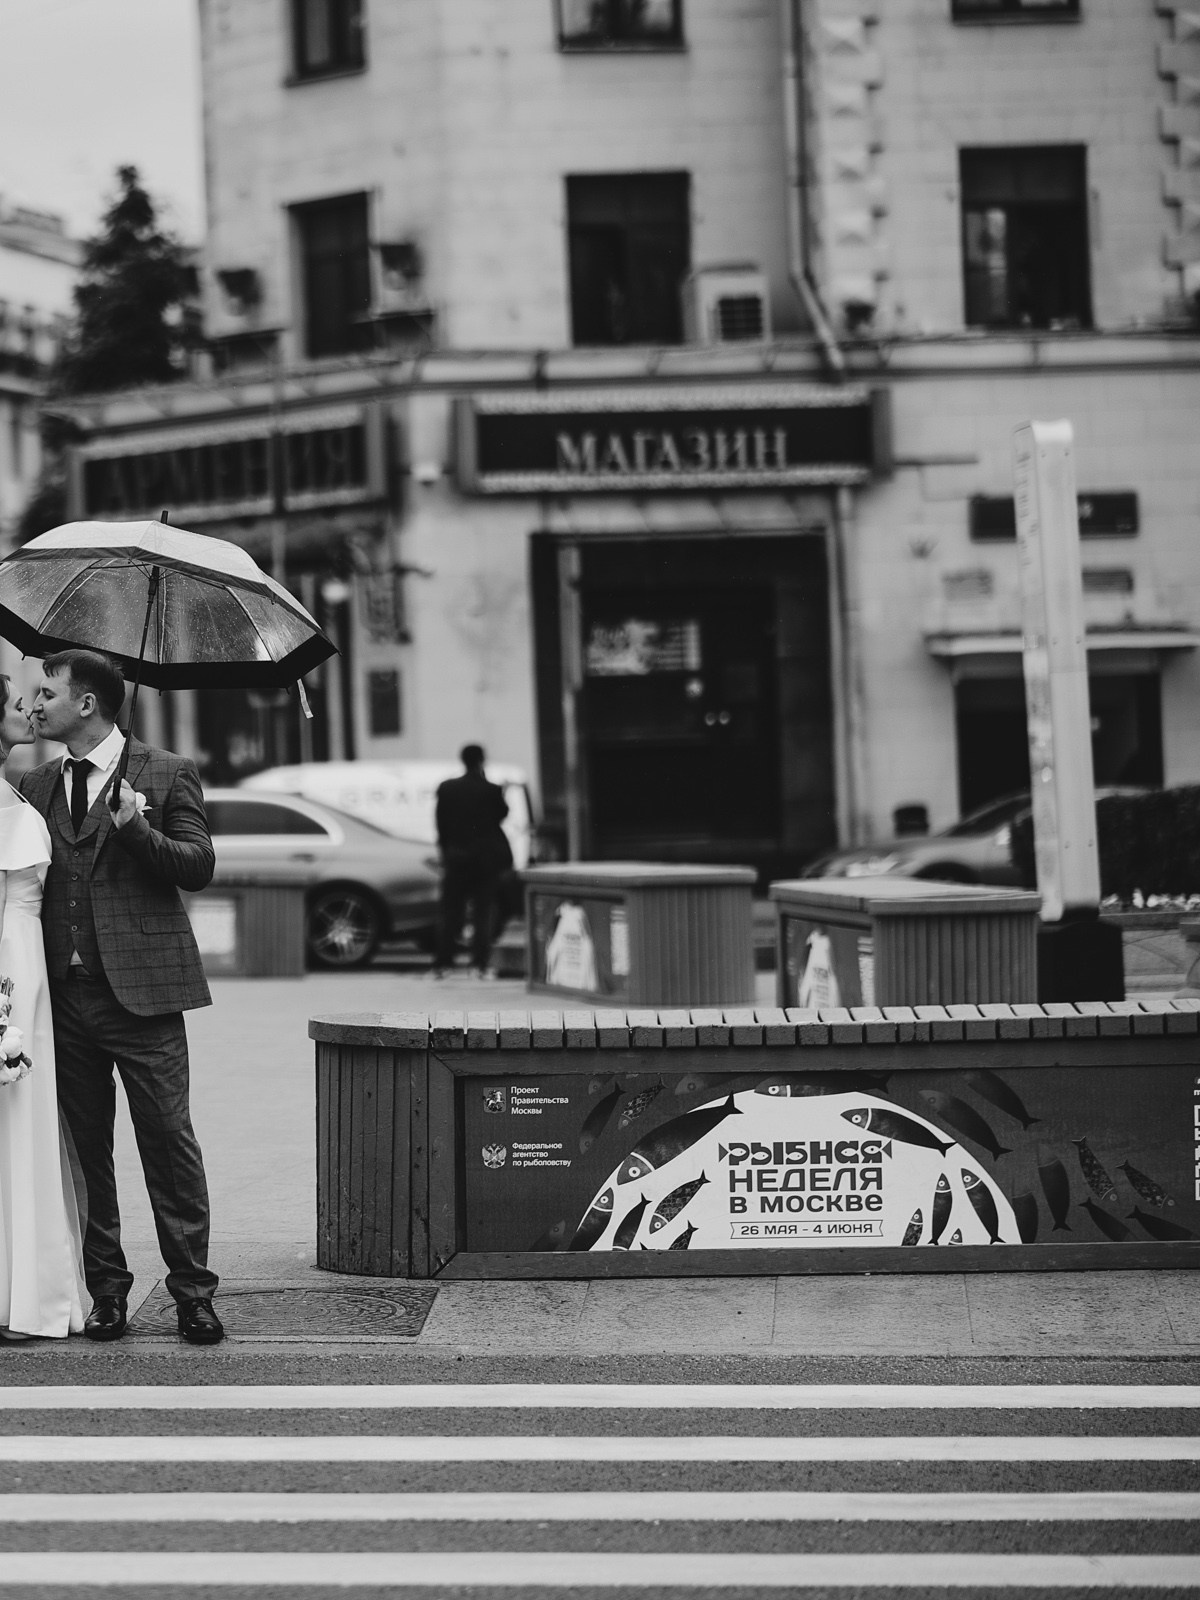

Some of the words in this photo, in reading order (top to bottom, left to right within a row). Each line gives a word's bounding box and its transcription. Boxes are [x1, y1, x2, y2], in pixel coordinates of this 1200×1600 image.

[555, 426, 788, 472] МАГАЗИН
[510, 1086, 540, 1095] Проект
[510, 1096, 569, 1106] Правительства
[511, 1107, 543, 1115] Москвы
[511, 1142, 563, 1151] Федеральное
[523, 1158, 572, 1168] рыболовству
[729, 1167, 883, 1193] НЕДЕЛЯ
[740, 1225, 759, 1236] 26
[764, 1225, 798, 1235] МАЯ
[813, 1224, 823, 1234] 4
[827, 1223, 873, 1234] ИЮНЯ
